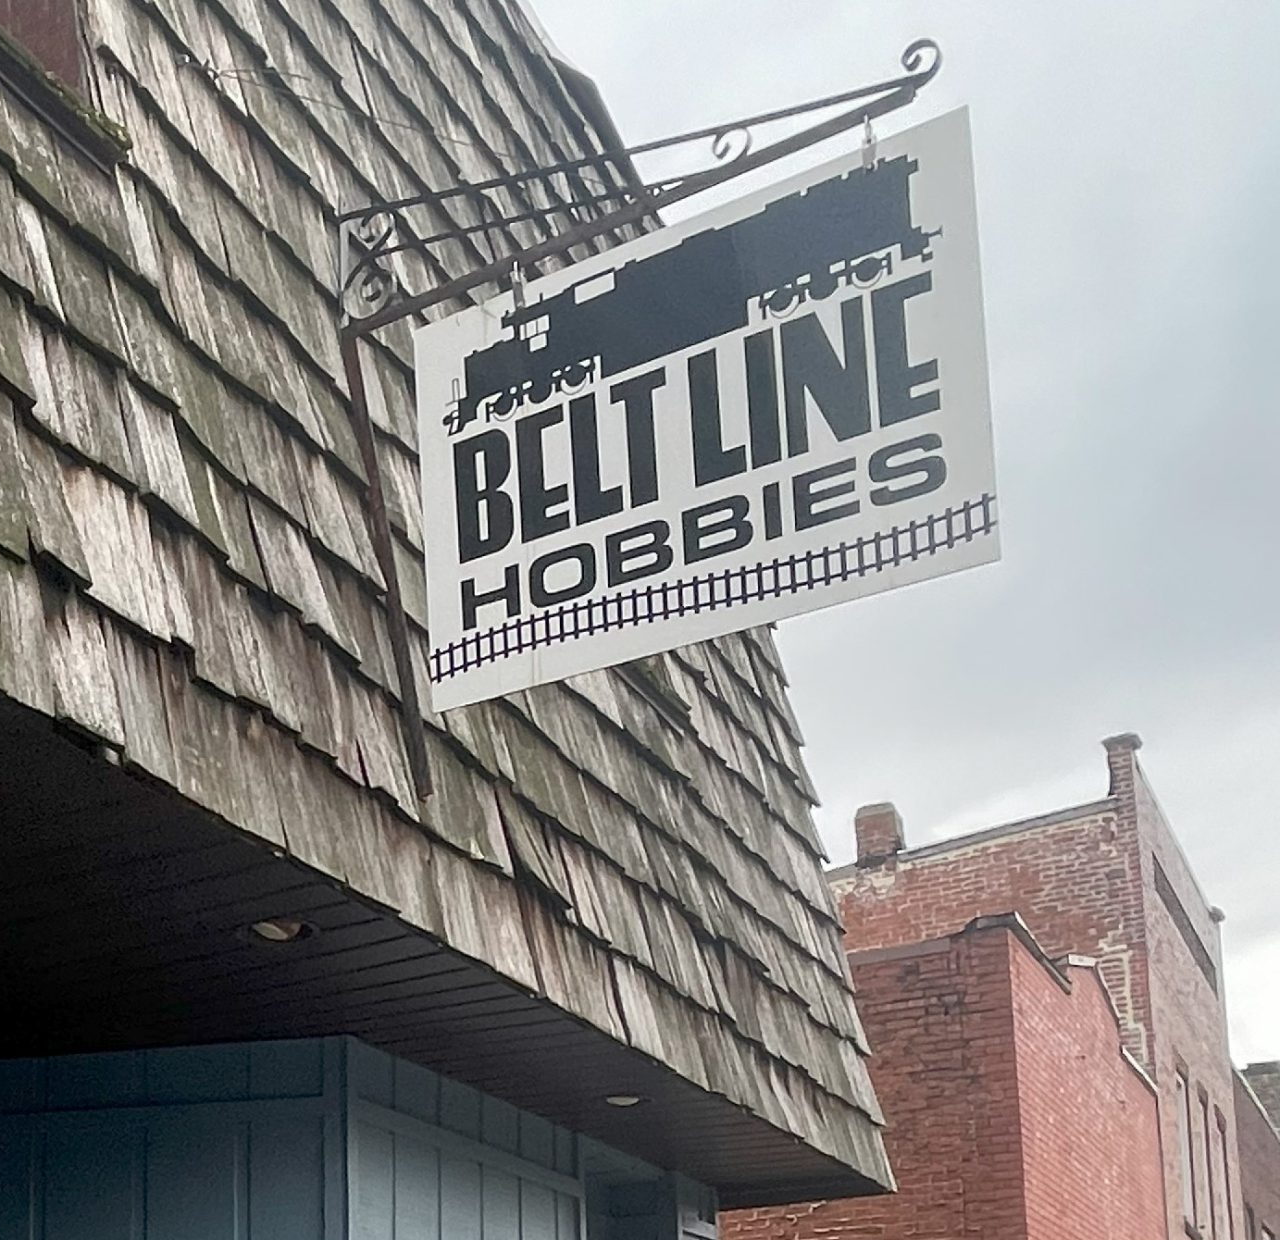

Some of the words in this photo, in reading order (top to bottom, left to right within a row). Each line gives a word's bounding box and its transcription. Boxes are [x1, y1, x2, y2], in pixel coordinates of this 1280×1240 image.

[453, 366, 666, 563] BELT
[688, 271, 941, 487] LINE
[461, 433, 947, 630] HOBBIES
